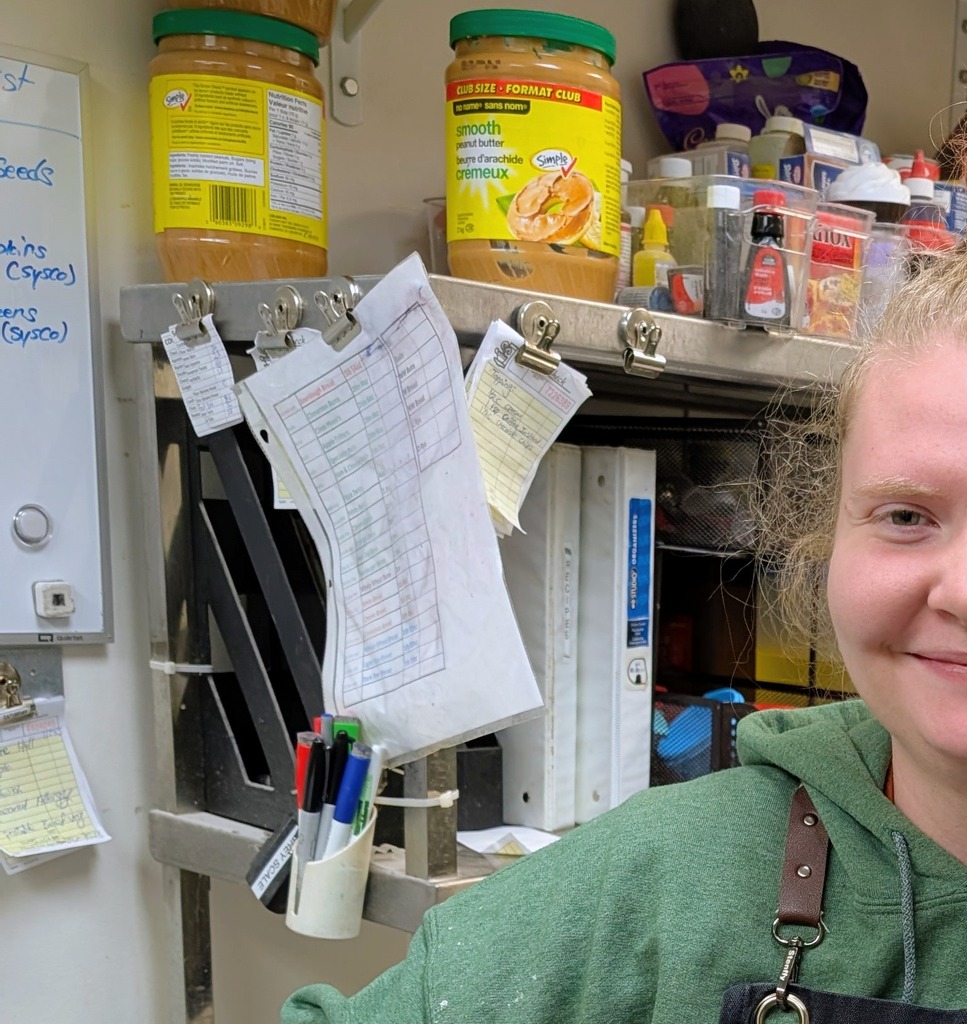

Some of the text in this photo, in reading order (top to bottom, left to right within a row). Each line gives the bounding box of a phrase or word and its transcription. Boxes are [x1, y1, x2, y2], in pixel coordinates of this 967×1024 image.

[456, 83, 581, 102] CLUB SIZE FORMAT CLUB
[484, 102, 503, 110] sans
[456, 120, 501, 138] smooth
[456, 139, 504, 151] peanut butter
[456, 153, 524, 166] beurre d'arachide
[536, 154, 568, 167] Simple
[257, 858, 281, 891] SCALE
[780, 949, 795, 981] Stenffy
